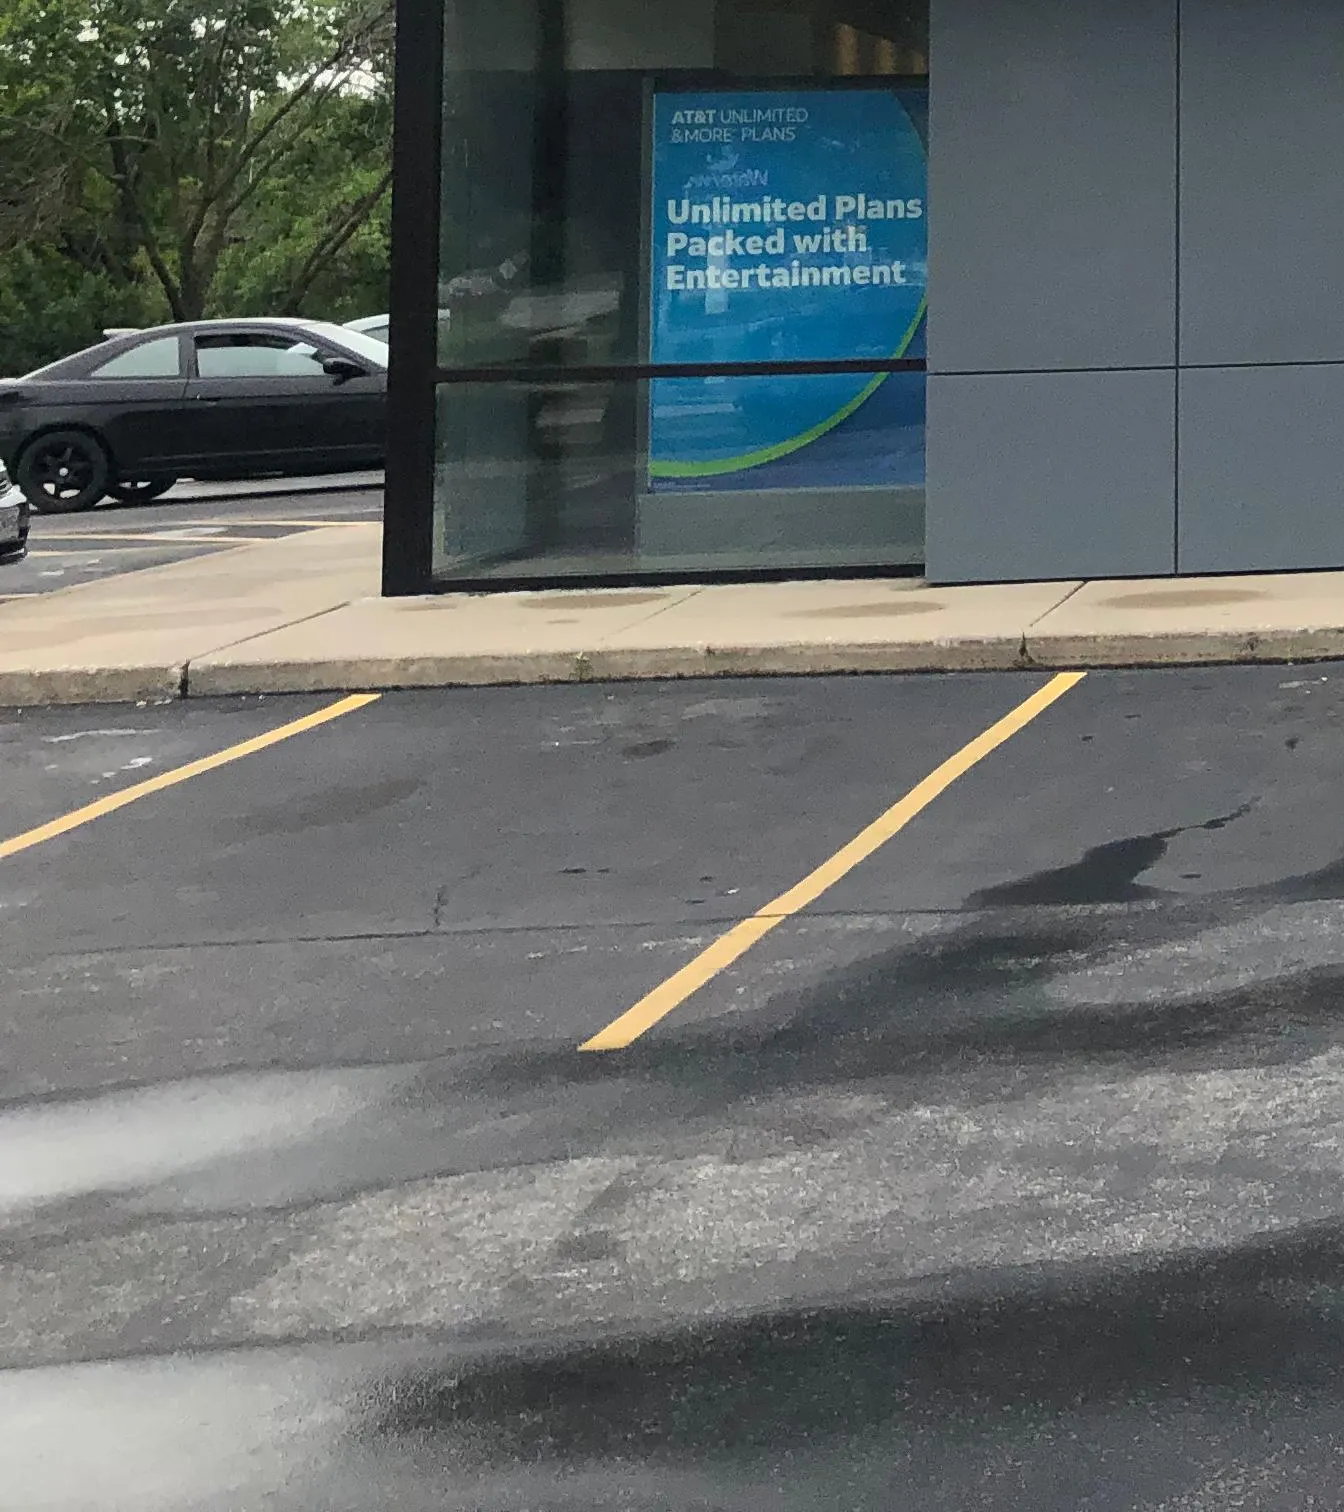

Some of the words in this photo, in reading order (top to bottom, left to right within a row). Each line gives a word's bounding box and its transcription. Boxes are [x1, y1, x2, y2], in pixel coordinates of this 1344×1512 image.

[671, 109, 717, 125] AT&T
[719, 107, 809, 125] UNLIMITED
[741, 126, 797, 142] PLANS
[667, 195, 827, 225] Unlimited
[834, 193, 923, 220] Plans
[666, 228, 786, 257] Packed
[793, 225, 868, 253] with
[666, 259, 907, 290] Entertainment
